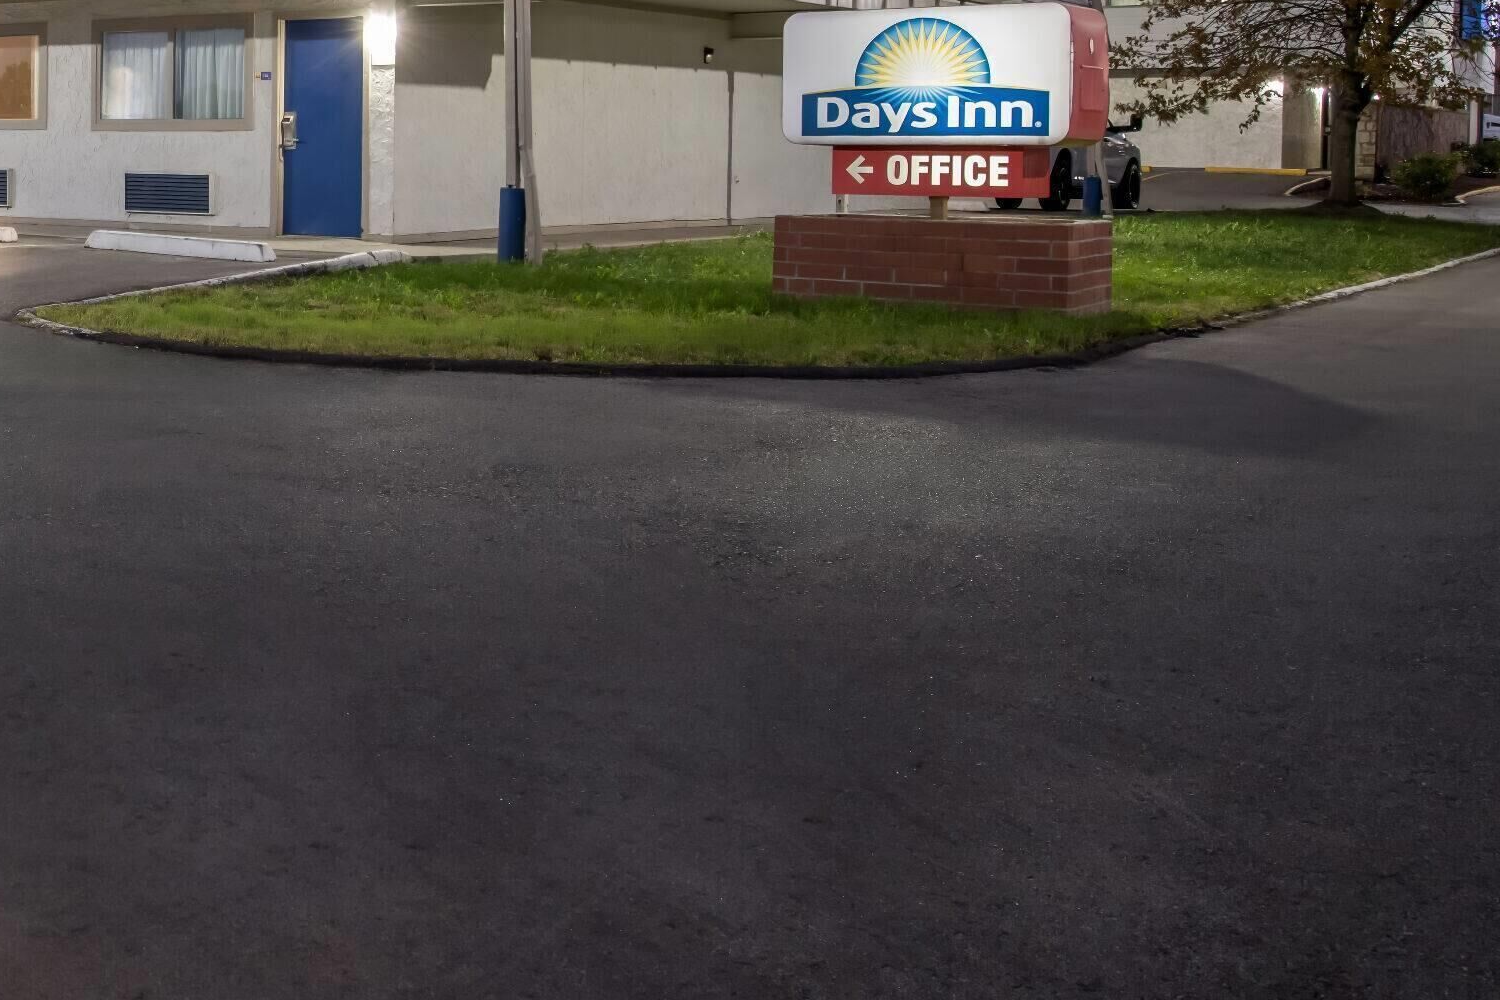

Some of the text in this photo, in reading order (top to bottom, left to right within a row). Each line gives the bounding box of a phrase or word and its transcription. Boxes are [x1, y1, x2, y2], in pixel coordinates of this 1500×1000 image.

[816, 95, 1034, 133] Days Inn
[886, 154, 1010, 187] OFFICE
